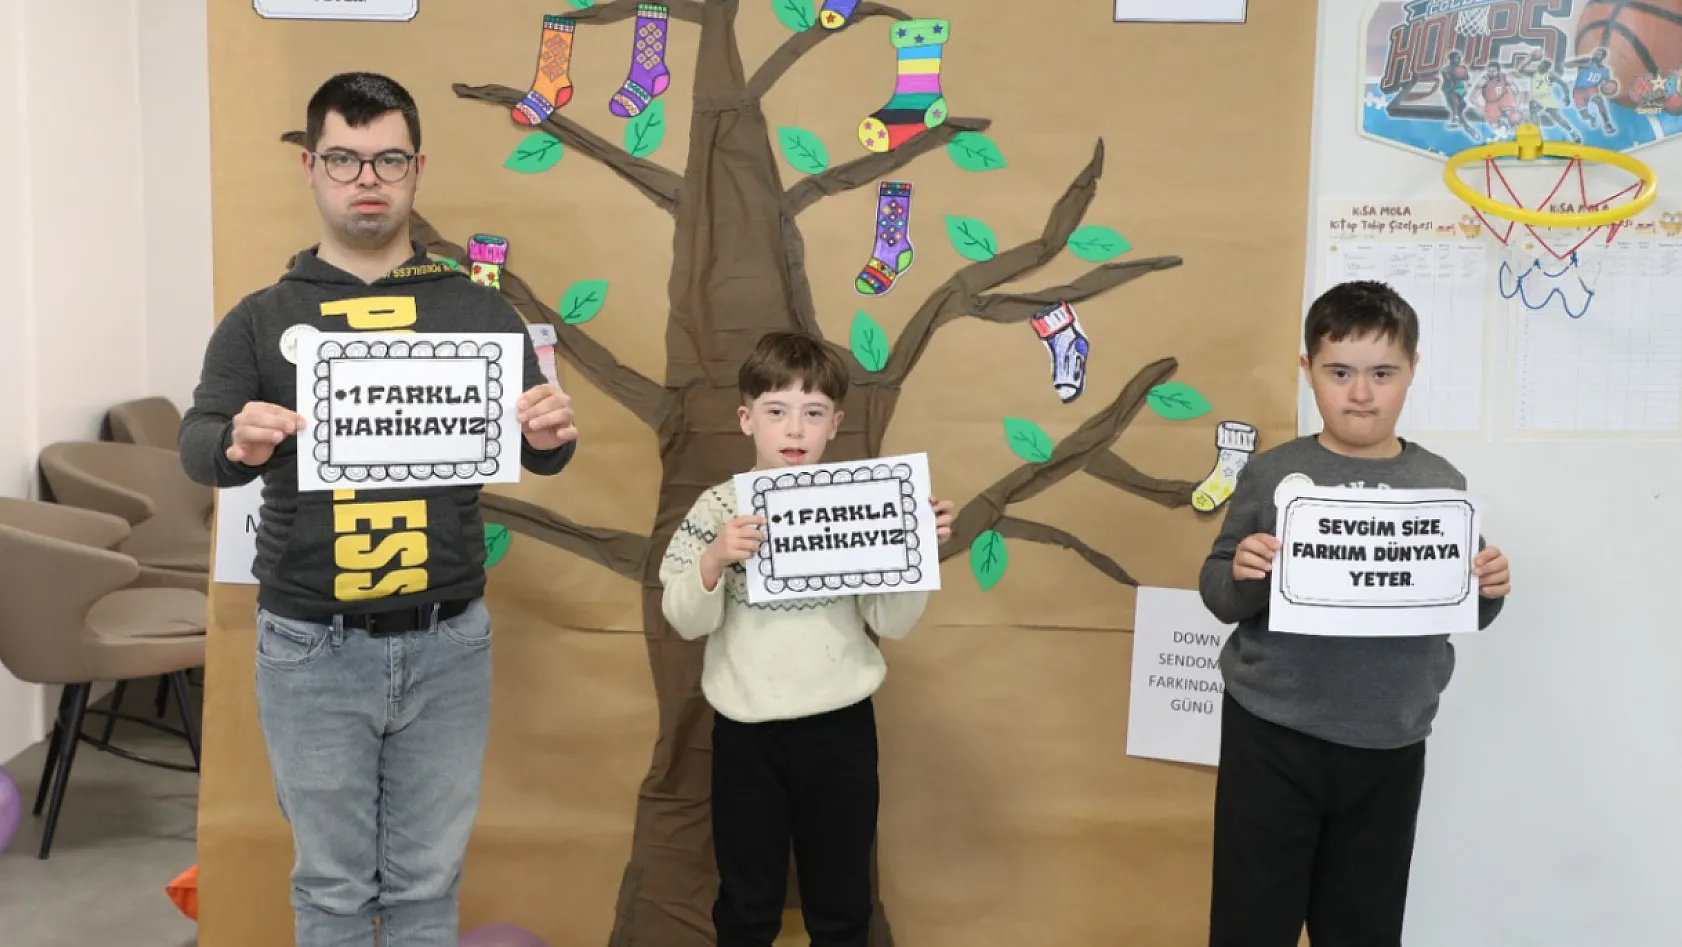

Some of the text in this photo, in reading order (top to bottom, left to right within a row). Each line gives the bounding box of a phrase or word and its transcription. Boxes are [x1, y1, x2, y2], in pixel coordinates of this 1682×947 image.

[1380, 205, 1411, 216] MOLA
[367, 385, 482, 404] FARKLA
[335, 409, 486, 436] HARİKAYIZ
[798, 501, 899, 526] FARKLA
[1318, 516, 1445, 537] SEVGİM SİZE,
[773, 526, 906, 553] HARİKAYIZ
[1292, 541, 1461, 562] FARKIM DÜNYAYA
[1348, 570, 1415, 587] YETER.
[1173, 631, 1220, 647] DOWN
[1159, 652, 1221, 671] SENDOM
[1148, 674, 1225, 694] FARKINDAL
[1170, 697, 1214, 715] GÜNÜ
